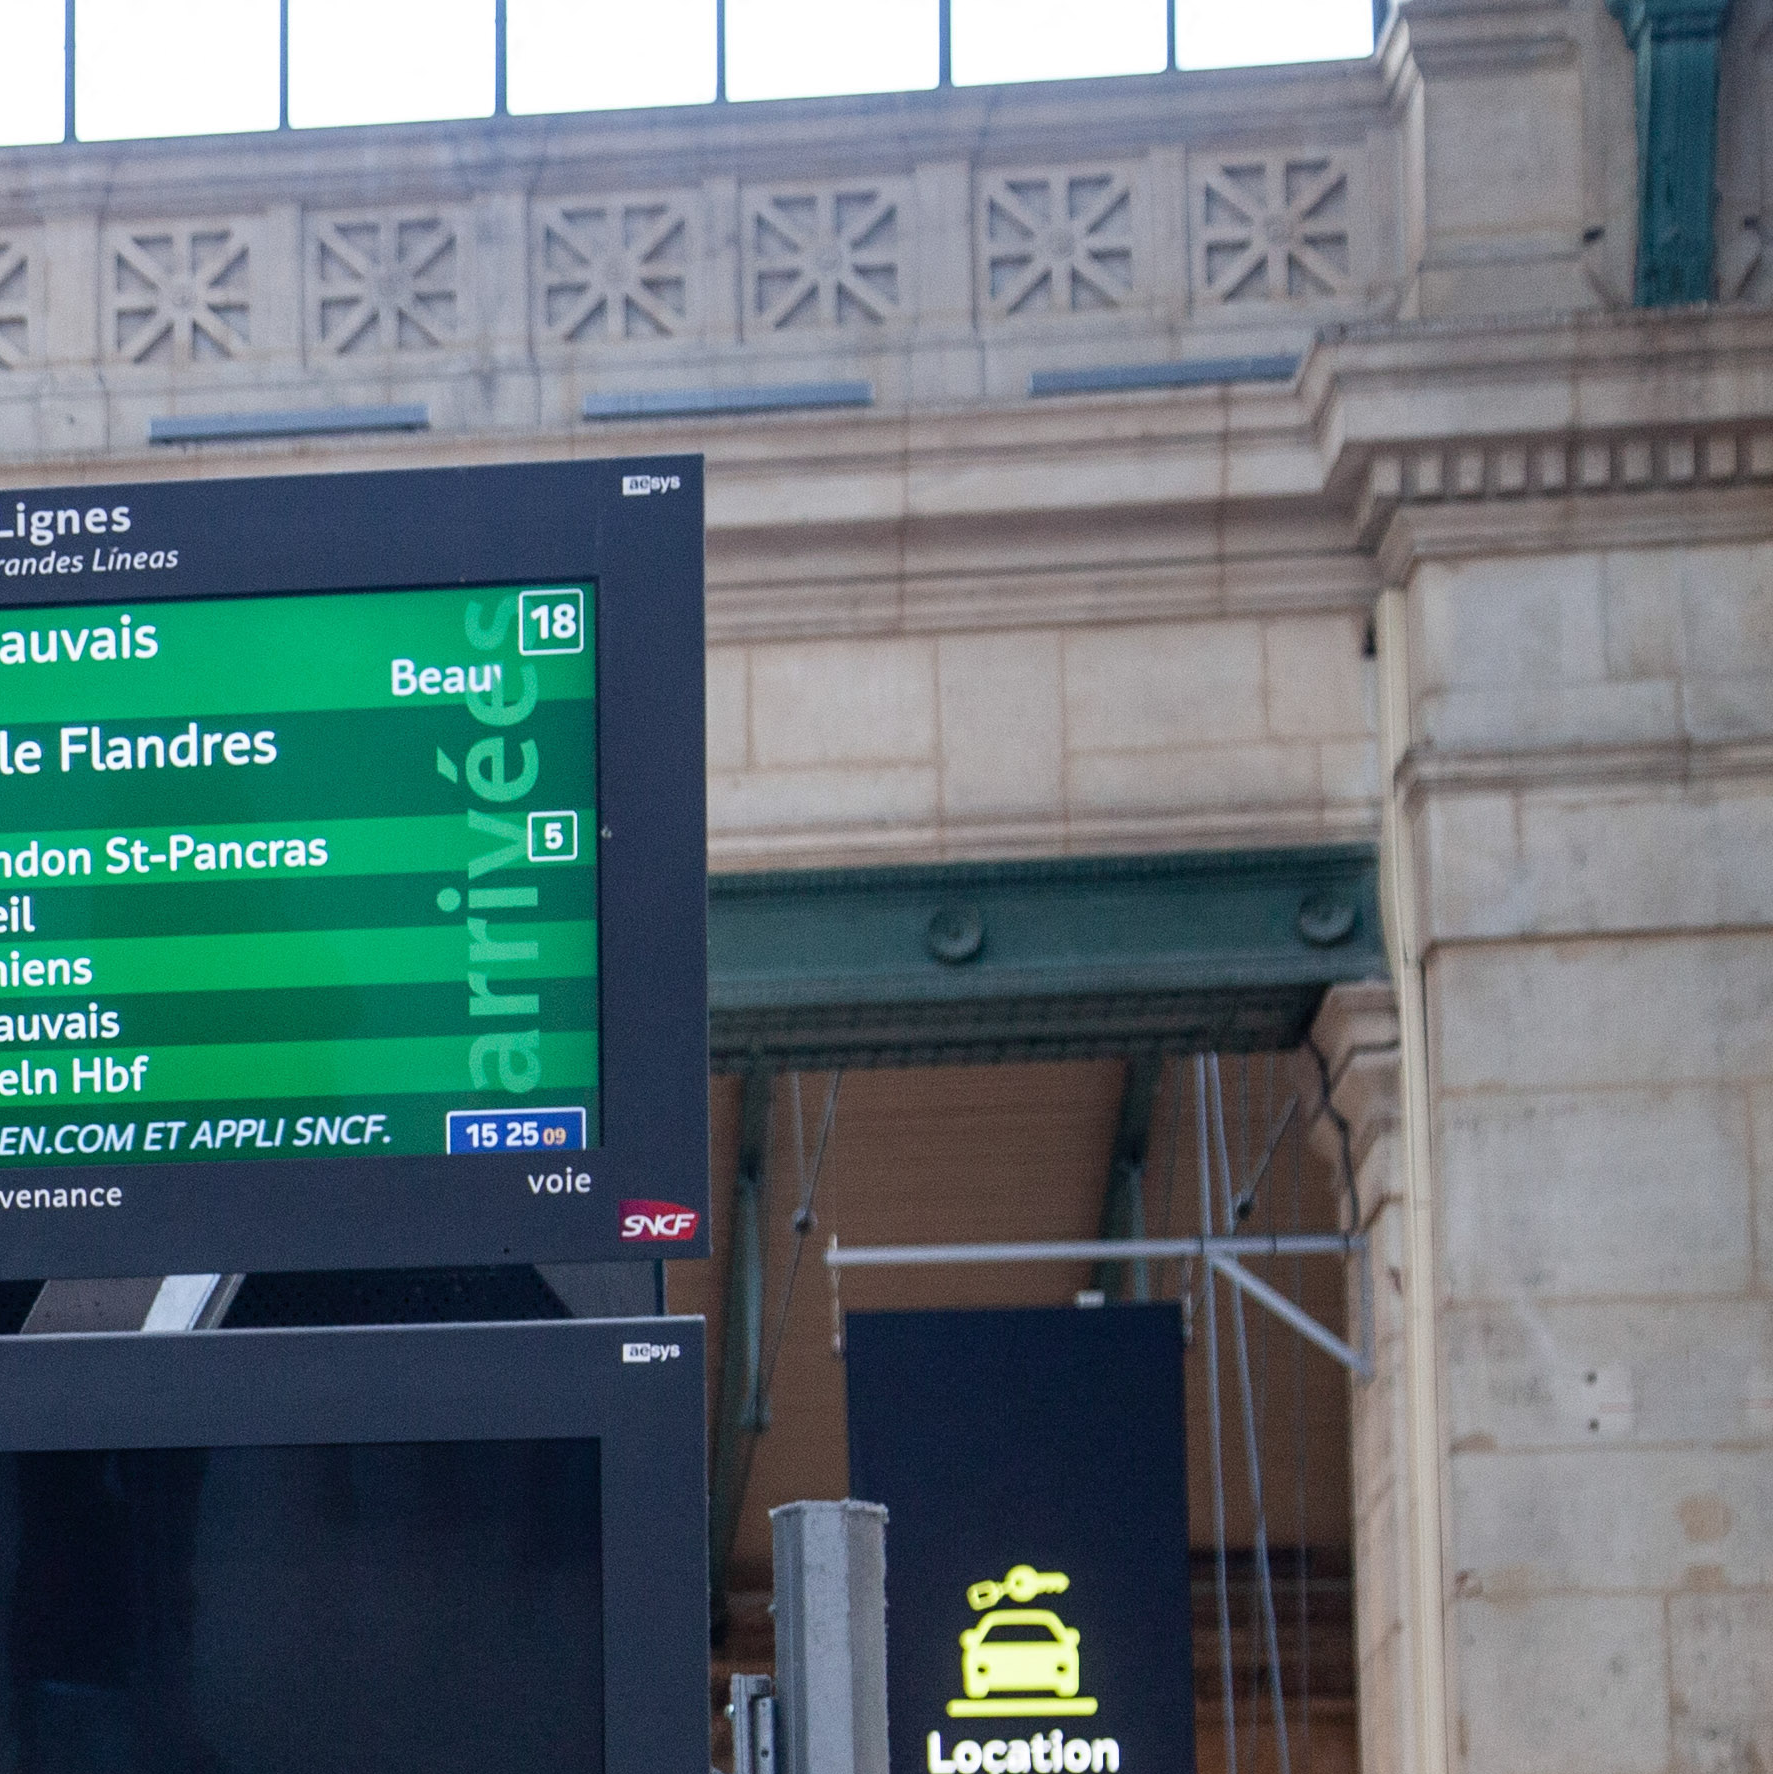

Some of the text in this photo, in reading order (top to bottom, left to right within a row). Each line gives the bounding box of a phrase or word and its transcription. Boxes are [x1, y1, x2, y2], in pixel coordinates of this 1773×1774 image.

[623, 474, 681, 496] aesys
[93, 545, 178, 572] Líneas
[531, 604, 577, 640] 18
[61, 722, 277, 770] Flandres
[107, 833, 328, 875] St-Pancras
[544, 823, 564, 849] 5
[436, 597, 541, 1093] arrivées
[73, 1055, 148, 1094] Hbf
[143, 1120, 186, 1152] ET
[190, 1117, 282, 1150] APPLI
[293, 1114, 392, 1146] SNCF.
[465, 1122, 498, 1148] 15
[506, 1121, 539, 1146] 25
[529, 1166, 592, 1195] voie
[927, 1729, 1119, 1774] Location
